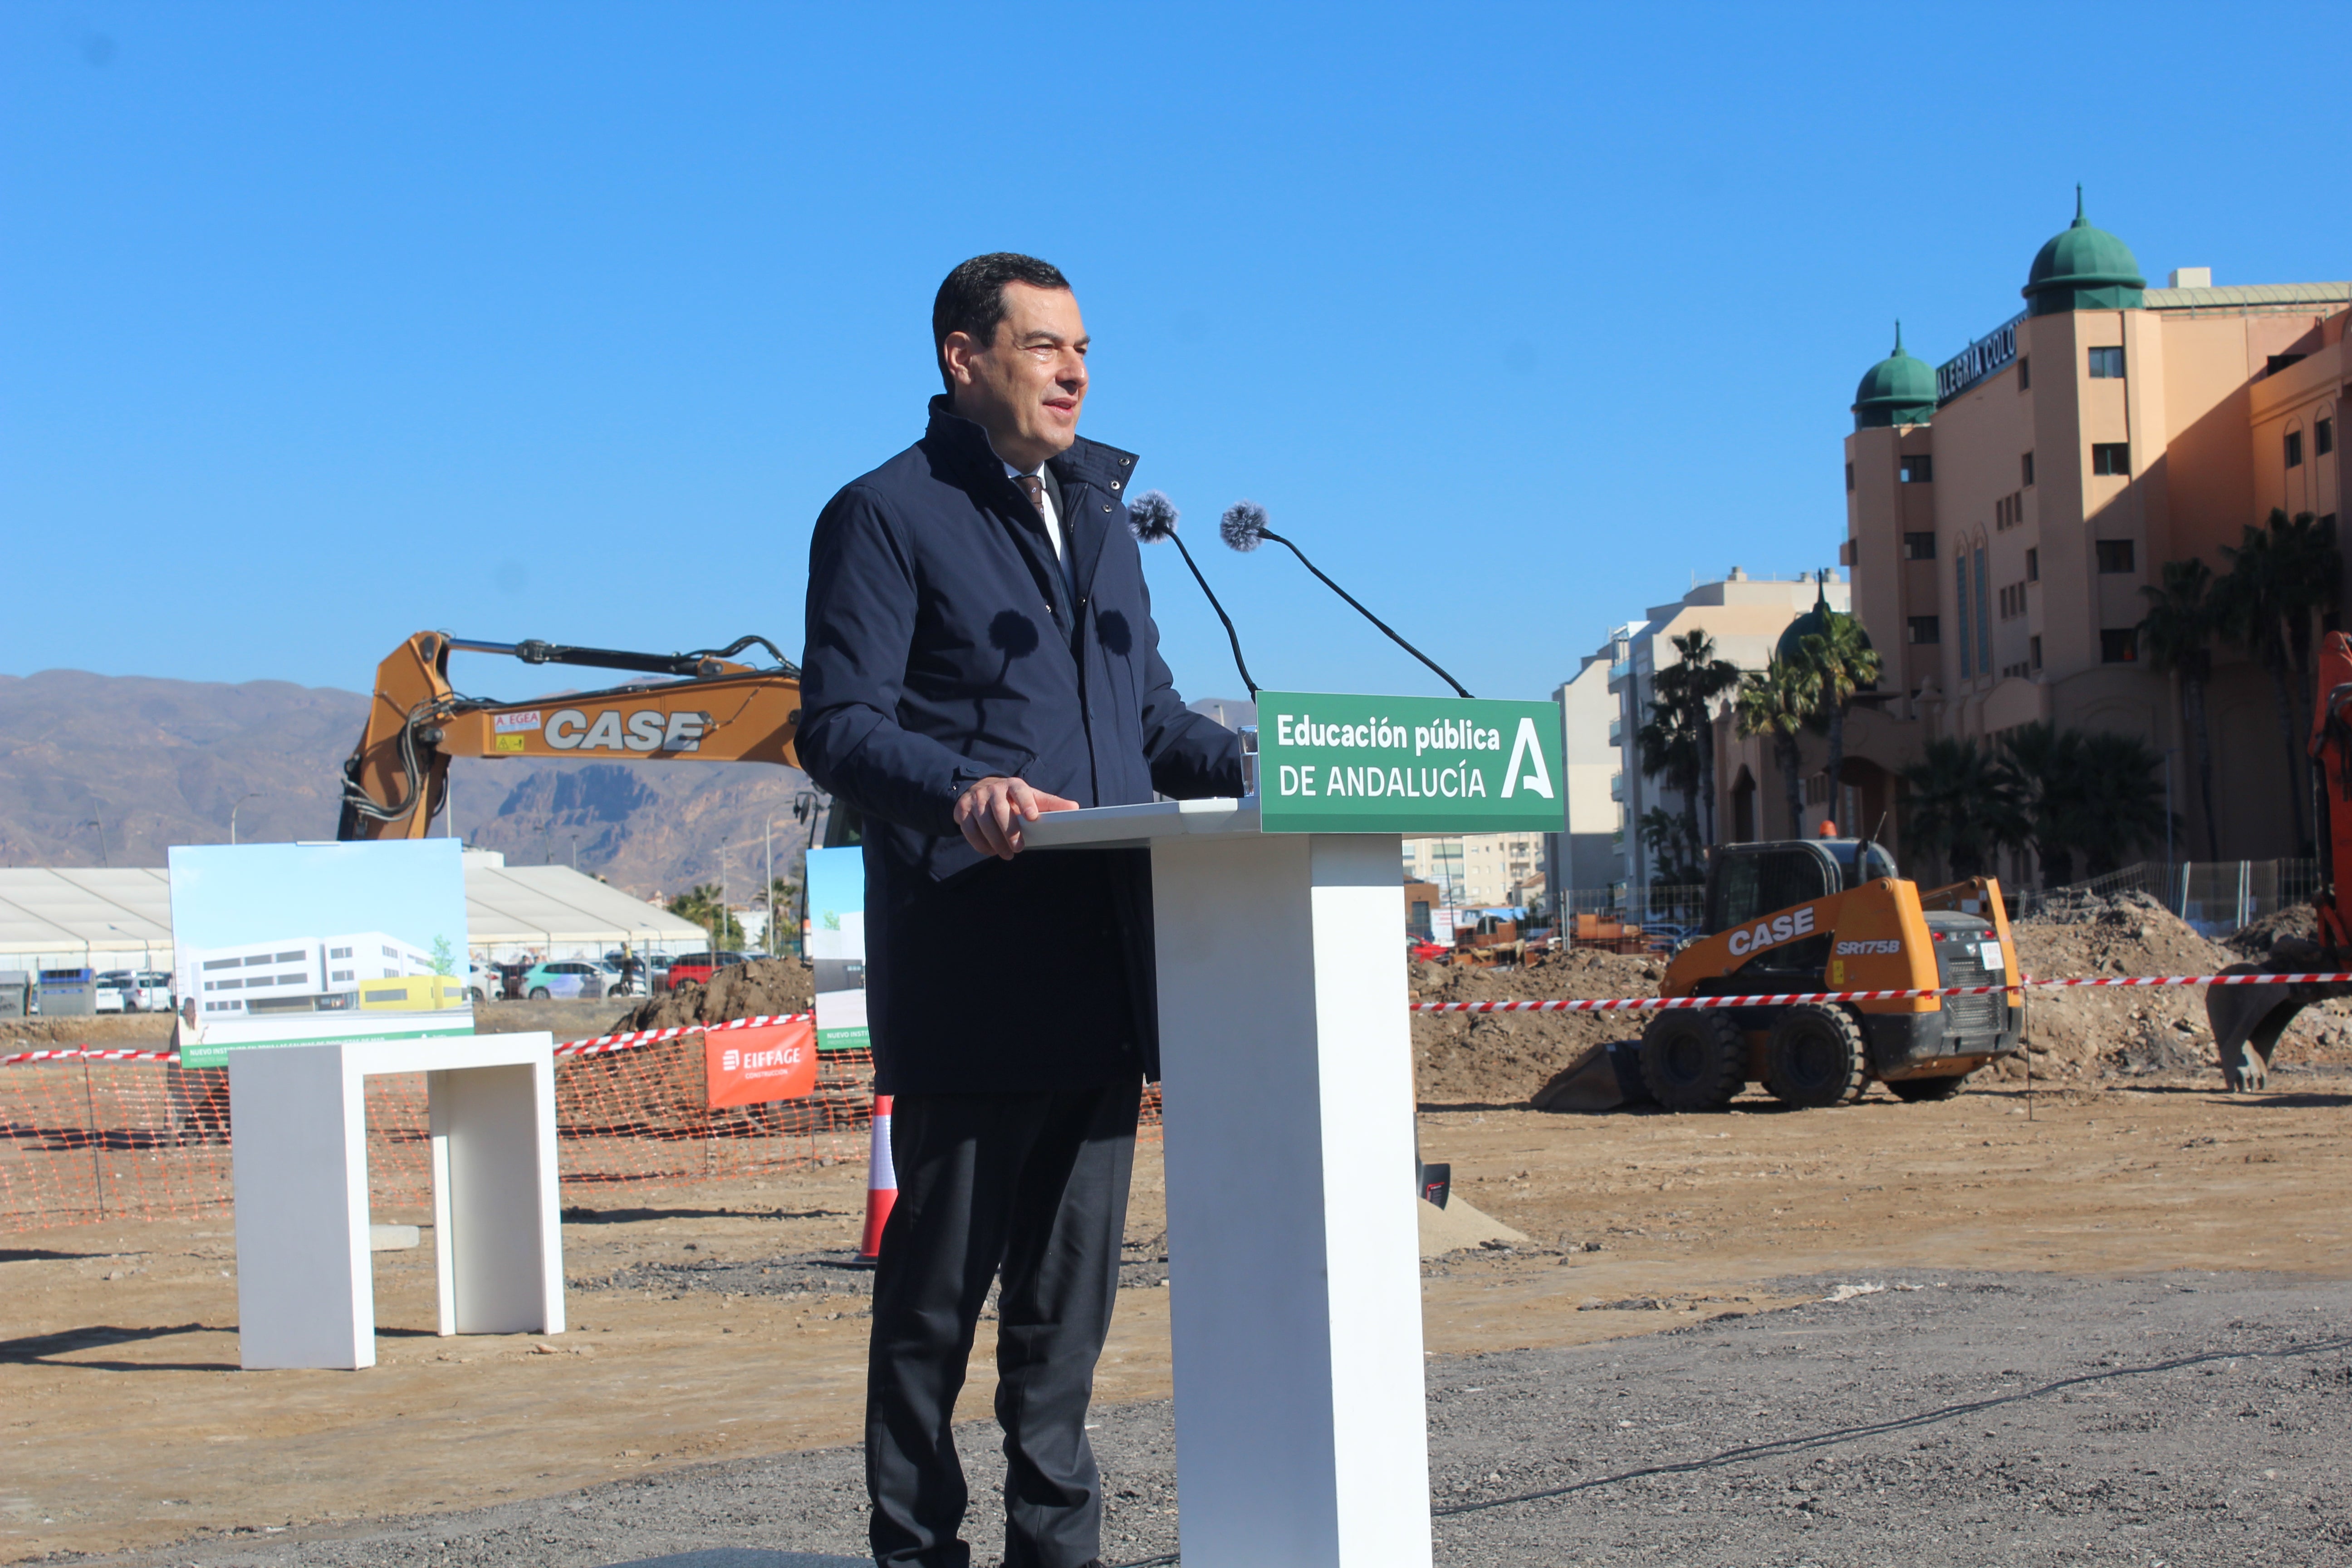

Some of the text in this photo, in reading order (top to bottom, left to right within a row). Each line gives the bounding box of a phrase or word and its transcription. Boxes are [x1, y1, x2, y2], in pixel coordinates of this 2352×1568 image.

[1937, 346, 1982, 400] ALEGRIA
[510, 712, 539, 725] EGEA
[544, 709, 705, 752] CASE
[1278, 714, 1500, 757] Educación pública
[1279, 759, 1486, 798] DE ANDALUCÍA
[1728, 906, 1815, 957] CASE
[1836, 940, 1901, 956] SR175B
[190, 1048, 211, 1056] NUEVO
[744, 1047, 801, 1069] EIFFAGE
